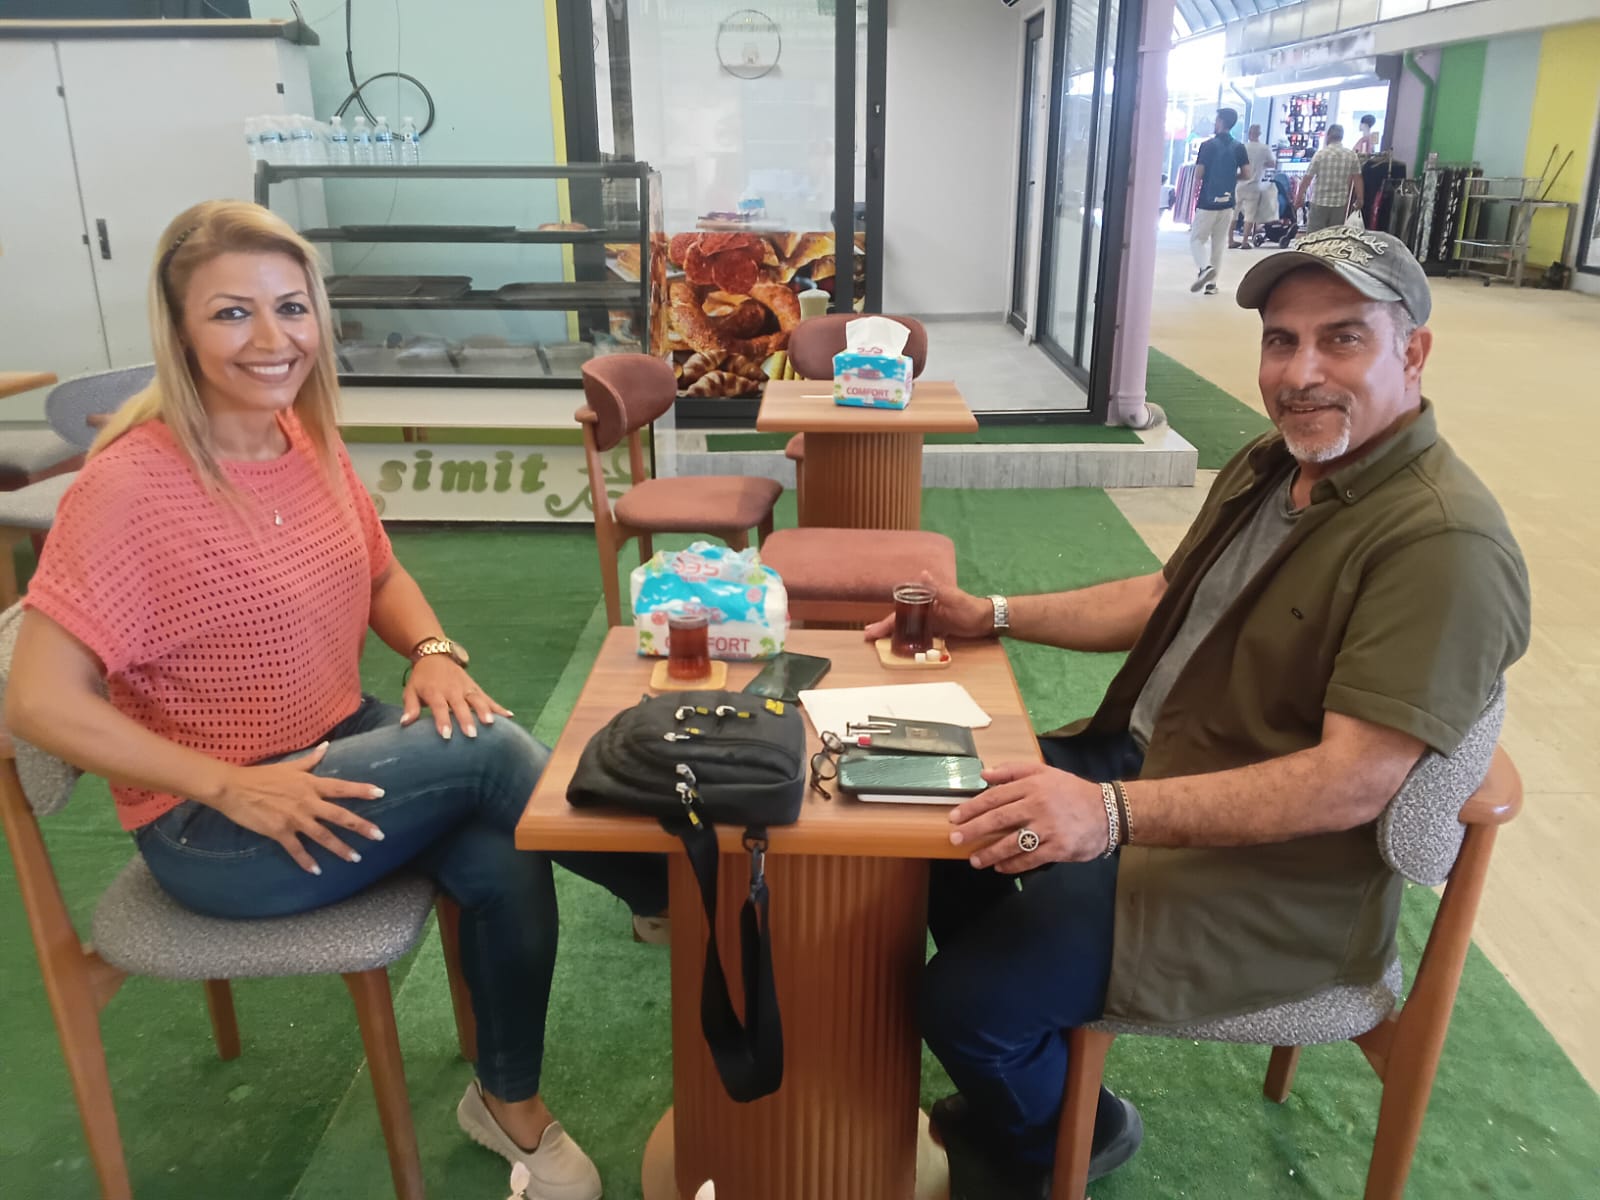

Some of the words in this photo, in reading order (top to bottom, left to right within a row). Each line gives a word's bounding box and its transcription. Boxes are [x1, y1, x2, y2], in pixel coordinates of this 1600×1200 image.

[846, 386, 890, 398] COMFORT
[377, 449, 548, 494] simit
[664, 636, 751, 653] FORT
